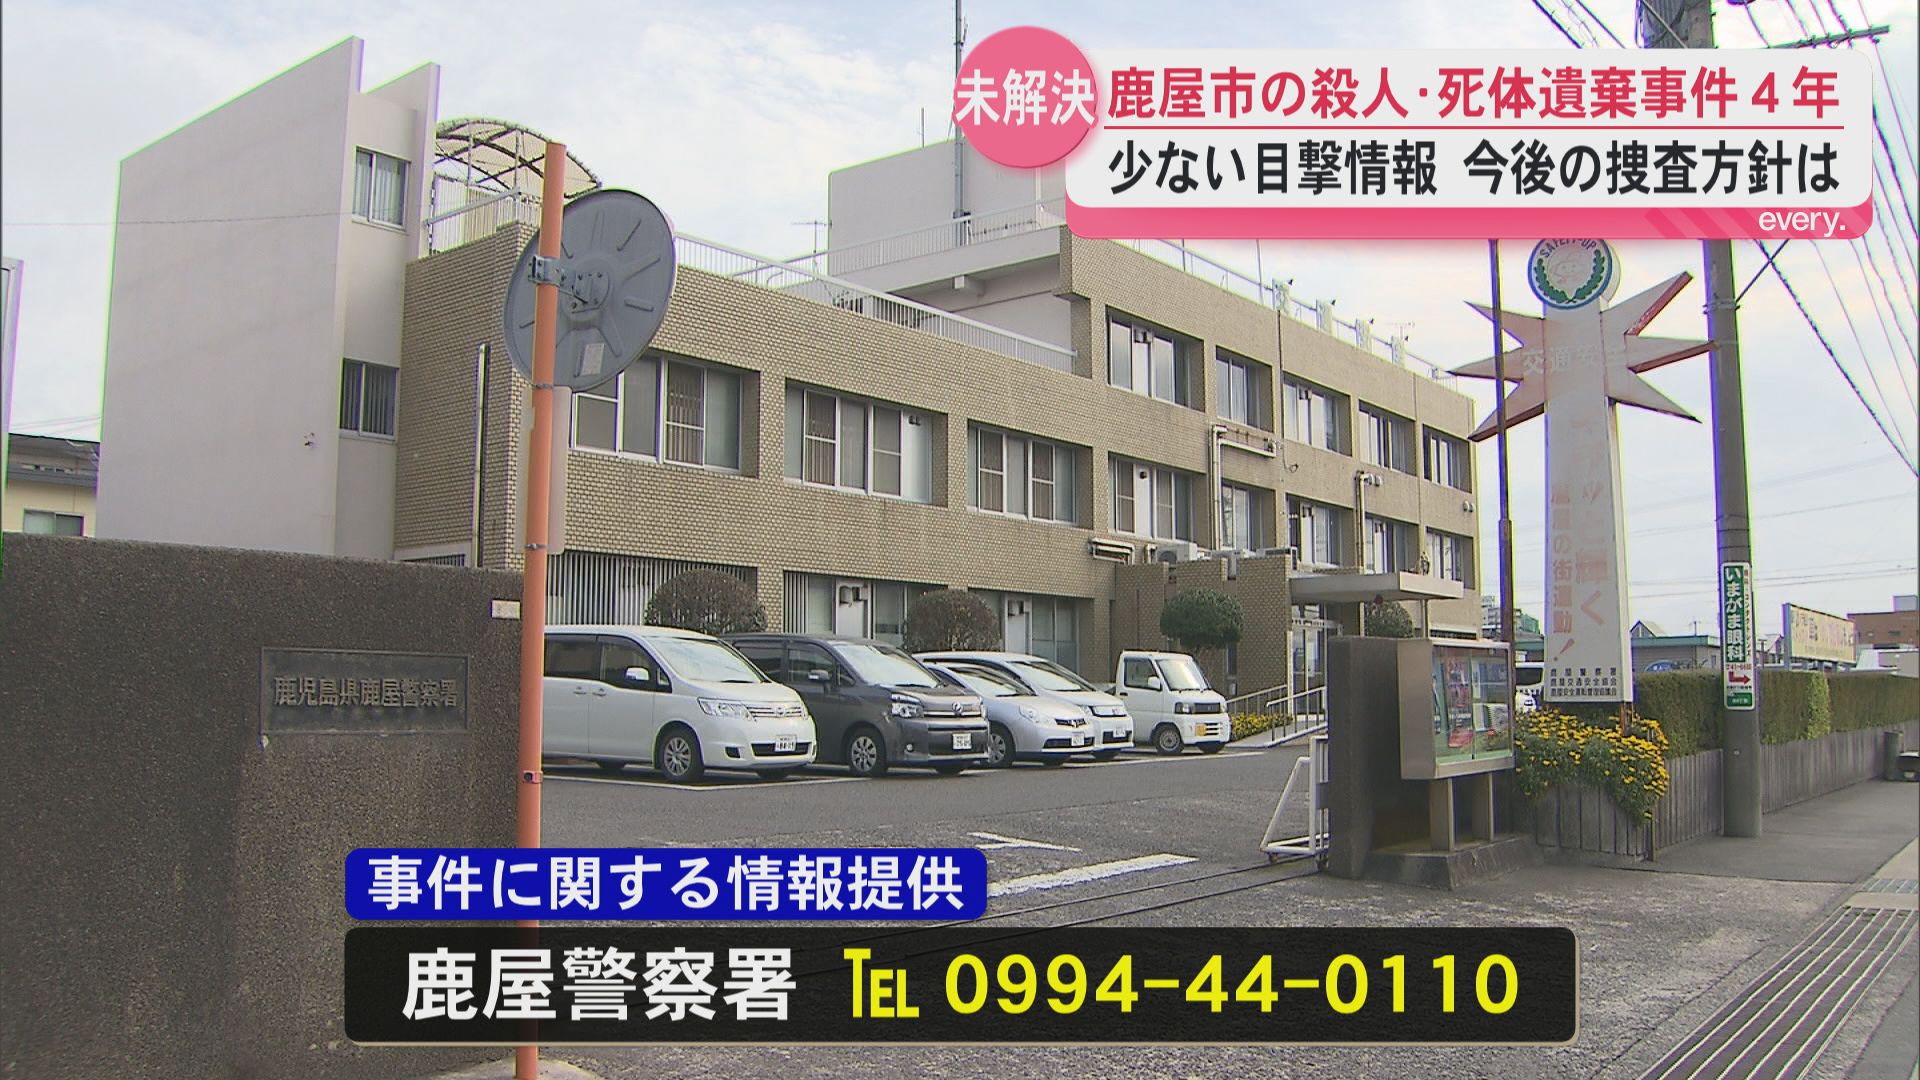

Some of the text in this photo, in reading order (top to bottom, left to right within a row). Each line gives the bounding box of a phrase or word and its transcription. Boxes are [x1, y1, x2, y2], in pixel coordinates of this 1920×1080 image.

[1725, 567, 1744, 662] いまがま眼科
[274, 676, 458, 707] 鹿児島県鹿屋警察署
